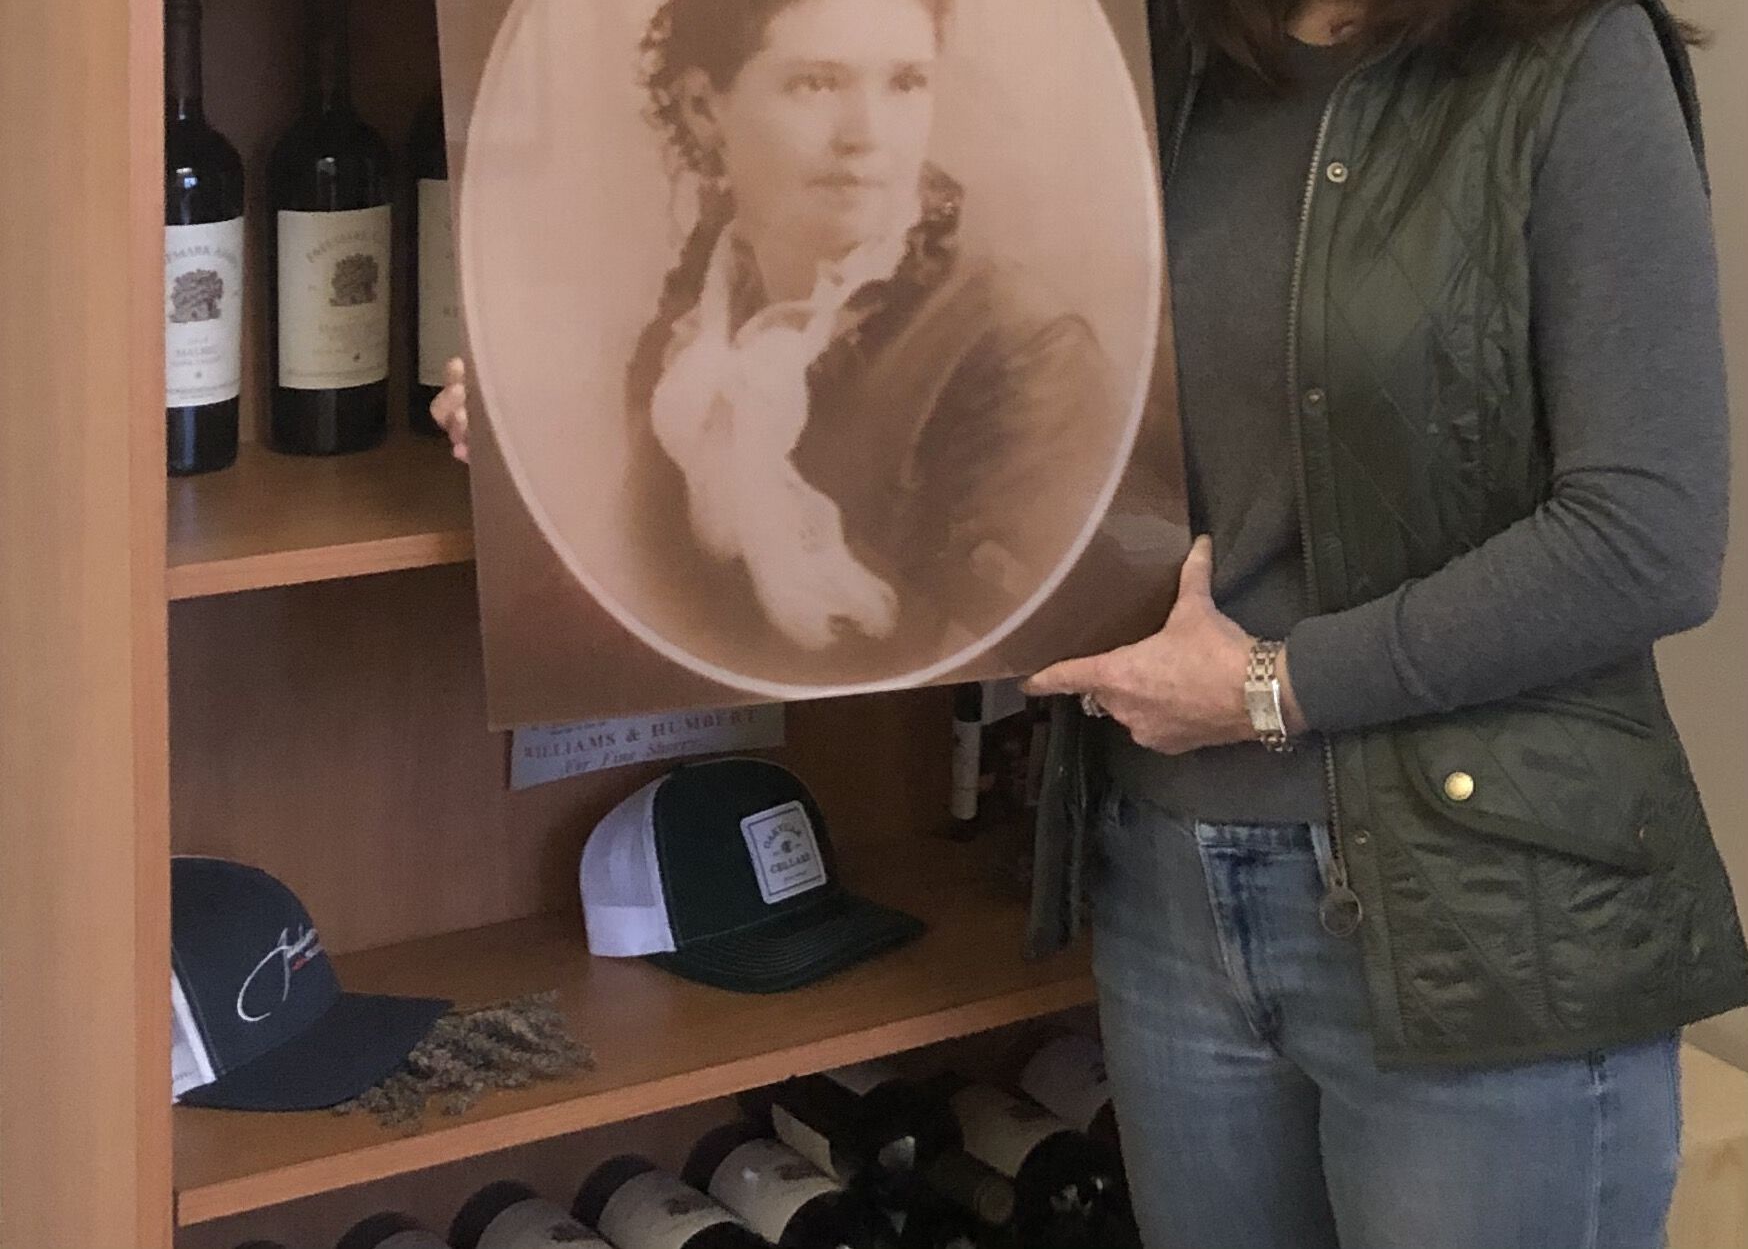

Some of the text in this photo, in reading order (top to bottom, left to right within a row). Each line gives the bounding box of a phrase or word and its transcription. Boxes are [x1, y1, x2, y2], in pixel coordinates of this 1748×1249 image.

[523, 734, 617, 760] WILLIAMS
[625, 728, 642, 744] &
[651, 708, 763, 738] HUMBERT
